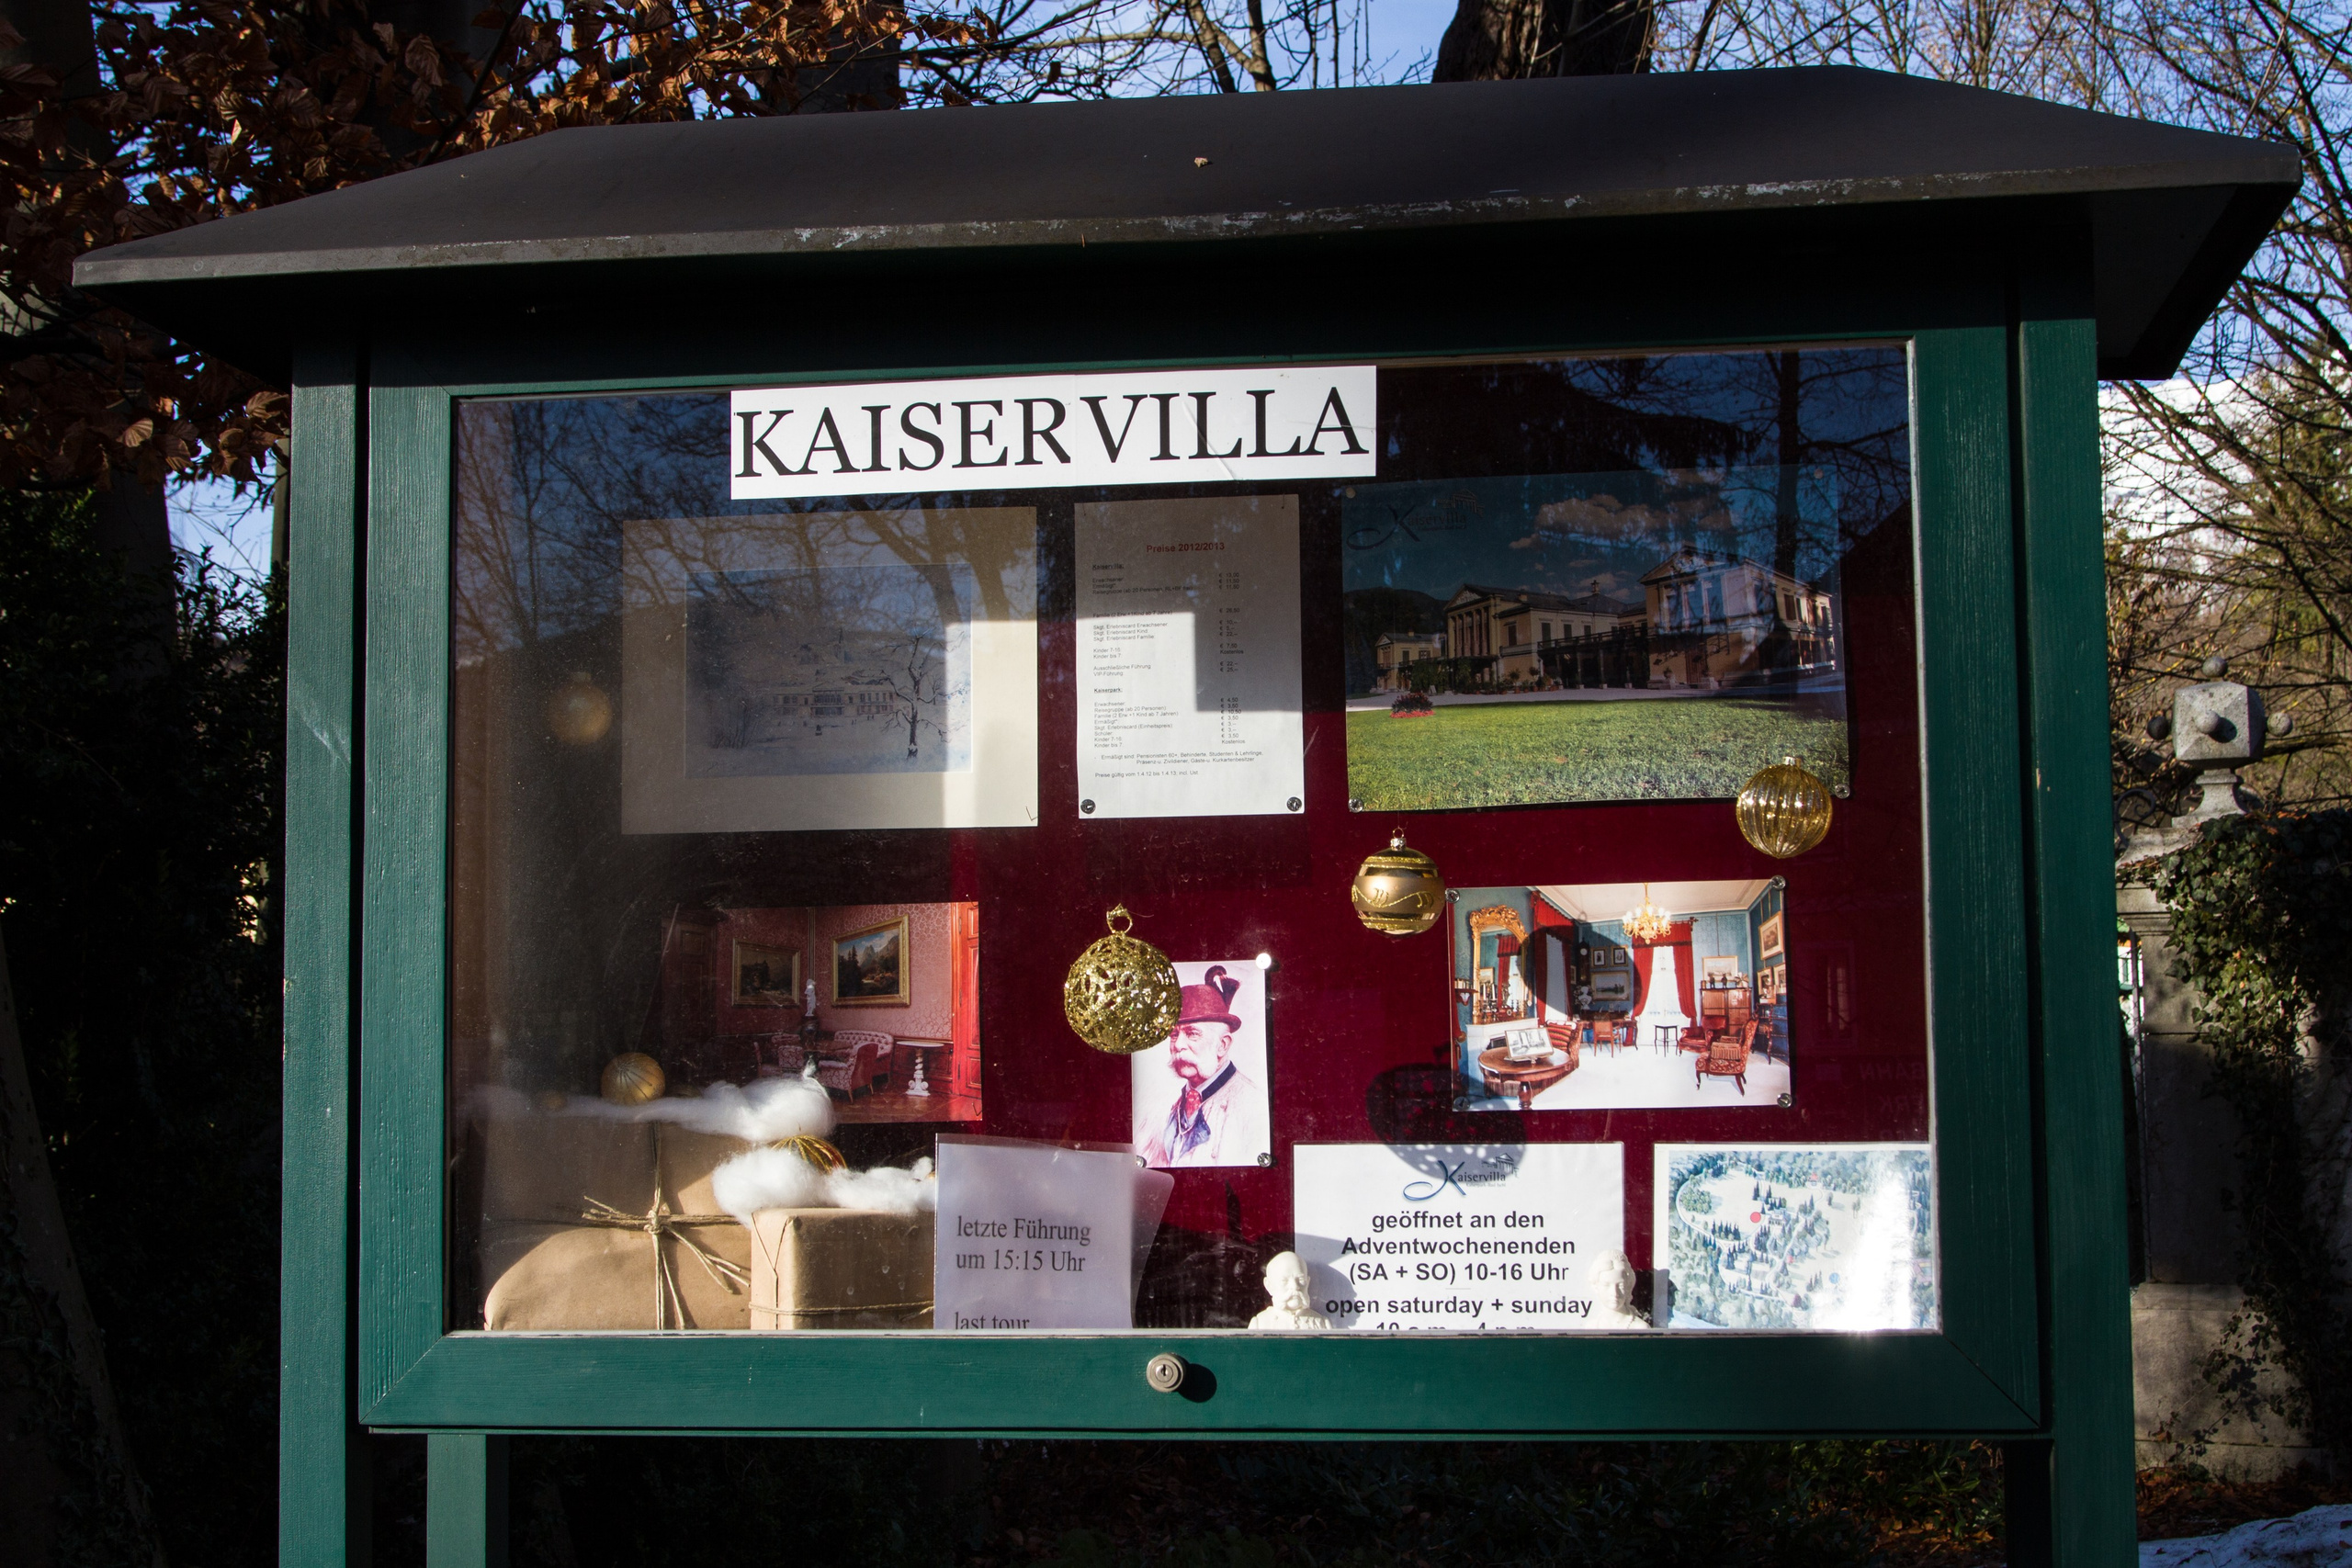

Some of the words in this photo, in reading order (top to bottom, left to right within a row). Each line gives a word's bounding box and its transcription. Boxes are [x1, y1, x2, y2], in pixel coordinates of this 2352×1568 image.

[734, 386, 1369, 478] KAISERVILLA
[1147, 545, 1175, 553] Preise
[1179, 543, 1225, 551] 2012/2013
[1403, 1160, 1506, 1201] Kaiservilla
[956, 1215, 1007, 1237] letzte
[1013, 1218, 1091, 1246] Führung
[1372, 1211, 1463, 1233] geöffnet
[1470, 1215, 1497, 1228] an
[1503, 1211, 1544, 1228] den
[1341, 1237, 1576, 1255] Adventwochenenden
[956, 1253, 985, 1269] um
[994, 1249, 1043, 1270] 15:15
[1050, 1250, 1086, 1271] Uhr
[1349, 1263, 1388, 1284] (SA
[1396, 1266, 1408, 1278] +
[1415, 1263, 1456, 1284] SO)
[1464, 1263, 1522, 1280] 10-16
[1531, 1263, 1569, 1280] Uhr
[1325, 1300, 1380, 1318] open
[1387, 1296, 1483, 1318] saturday
[1491, 1298, 1504, 1311] +
[1511, 1296, 1592, 1318] sunday
[955, 1312, 986, 1329] last
